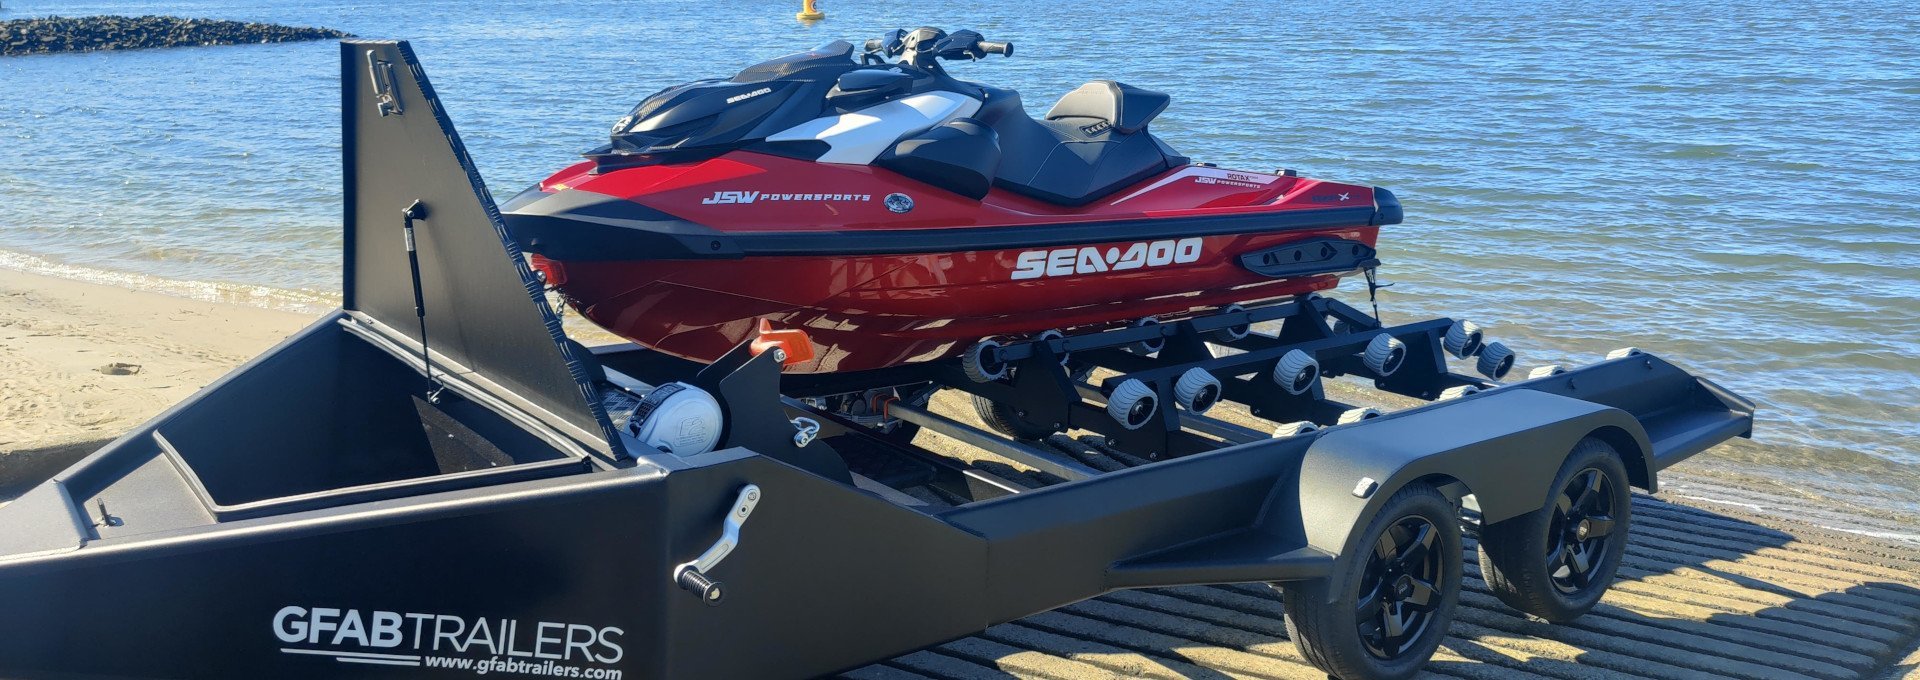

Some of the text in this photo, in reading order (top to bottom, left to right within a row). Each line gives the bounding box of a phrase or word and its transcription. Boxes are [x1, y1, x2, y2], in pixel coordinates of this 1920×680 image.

[1194, 177, 1261, 189] JSW POWERSPORTS
[702, 191, 871, 204] JSW POWERSPORTS
[425, 656, 623, 680] www.gfabtrailers.com
